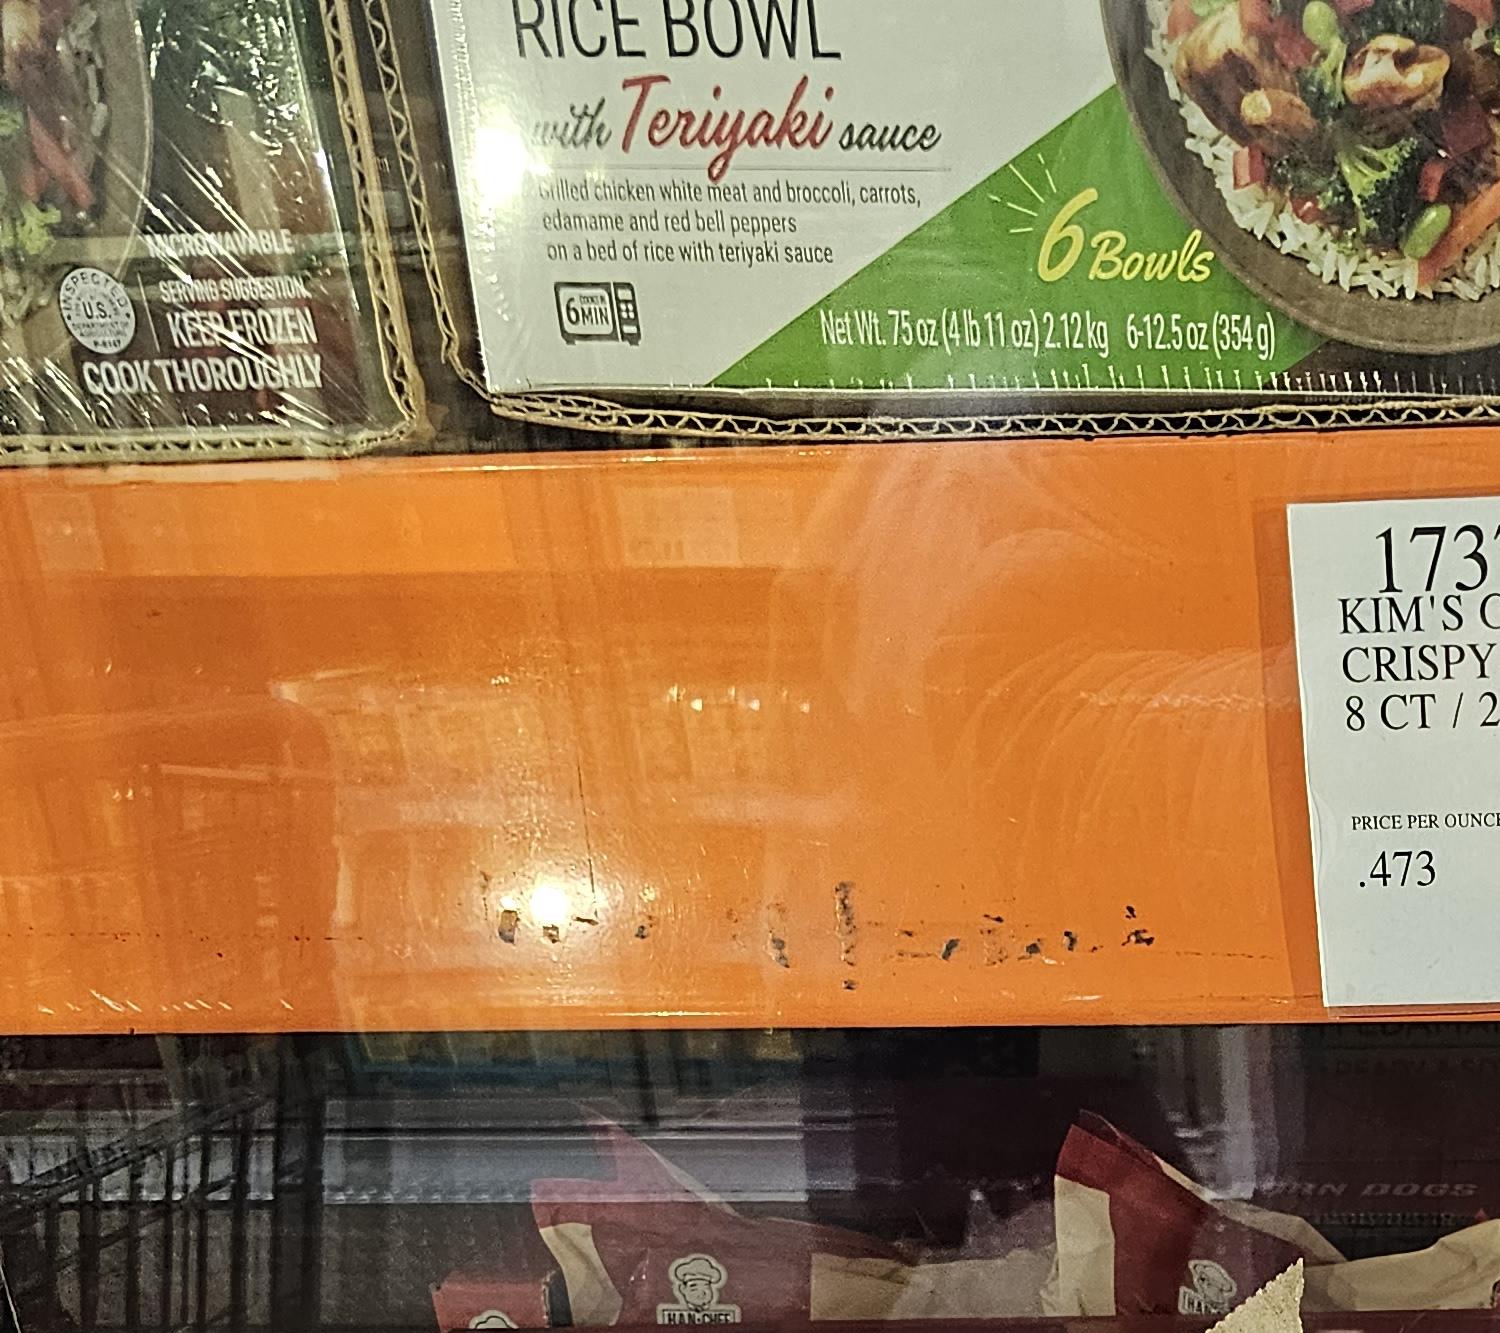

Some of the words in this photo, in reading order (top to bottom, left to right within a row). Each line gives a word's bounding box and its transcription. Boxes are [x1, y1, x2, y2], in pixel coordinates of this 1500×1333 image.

[513, 0, 647, 59] RICE
[664, 0, 842, 60] BOWL
[532, 97, 612, 151] with
[620, 73, 835, 184] Teriyaki
[838, 120, 942, 153] sauce
[1037, 187, 1099, 283] 6
[1088, 229, 1215, 284] Bowls
[166, 310, 224, 348] KEEP
[228, 307, 318, 344] FROZEN
[819, 309, 852, 347] Net
[854, 311, 887, 347] Wt.
[887, 310, 912, 347] 75
[916, 321, 938, 347] oz
[941, 312, 961, 356] (4
[963, 312, 980, 347] lb
[983, 312, 1006, 347] 11
[1011, 310, 1039, 358] oz)
[1042, 312, 1083, 350] 2.12
[1086, 312, 1110, 359] kg
[1126, 312, 1184, 350] 6-12.5
[1186, 321, 1208, 350] oz
[1212, 311, 1254, 359] (354
[1256, 312, 1276, 361] g)
[82, 358, 158, 396] COOK
[154, 353, 324, 392] THOROUGHLY
[1339, 594, 1464, 635] KIM'S
[1340, 641, 1500, 684] CRISPY
[1344, 694, 1367, 732] 8
[1379, 692, 1437, 731] CT
[1451, 690, 1466, 729] /
[1350, 813, 1404, 832] PRICE
[1406, 812, 1440, 831] PER
[1357, 848, 1437, 888] .473
